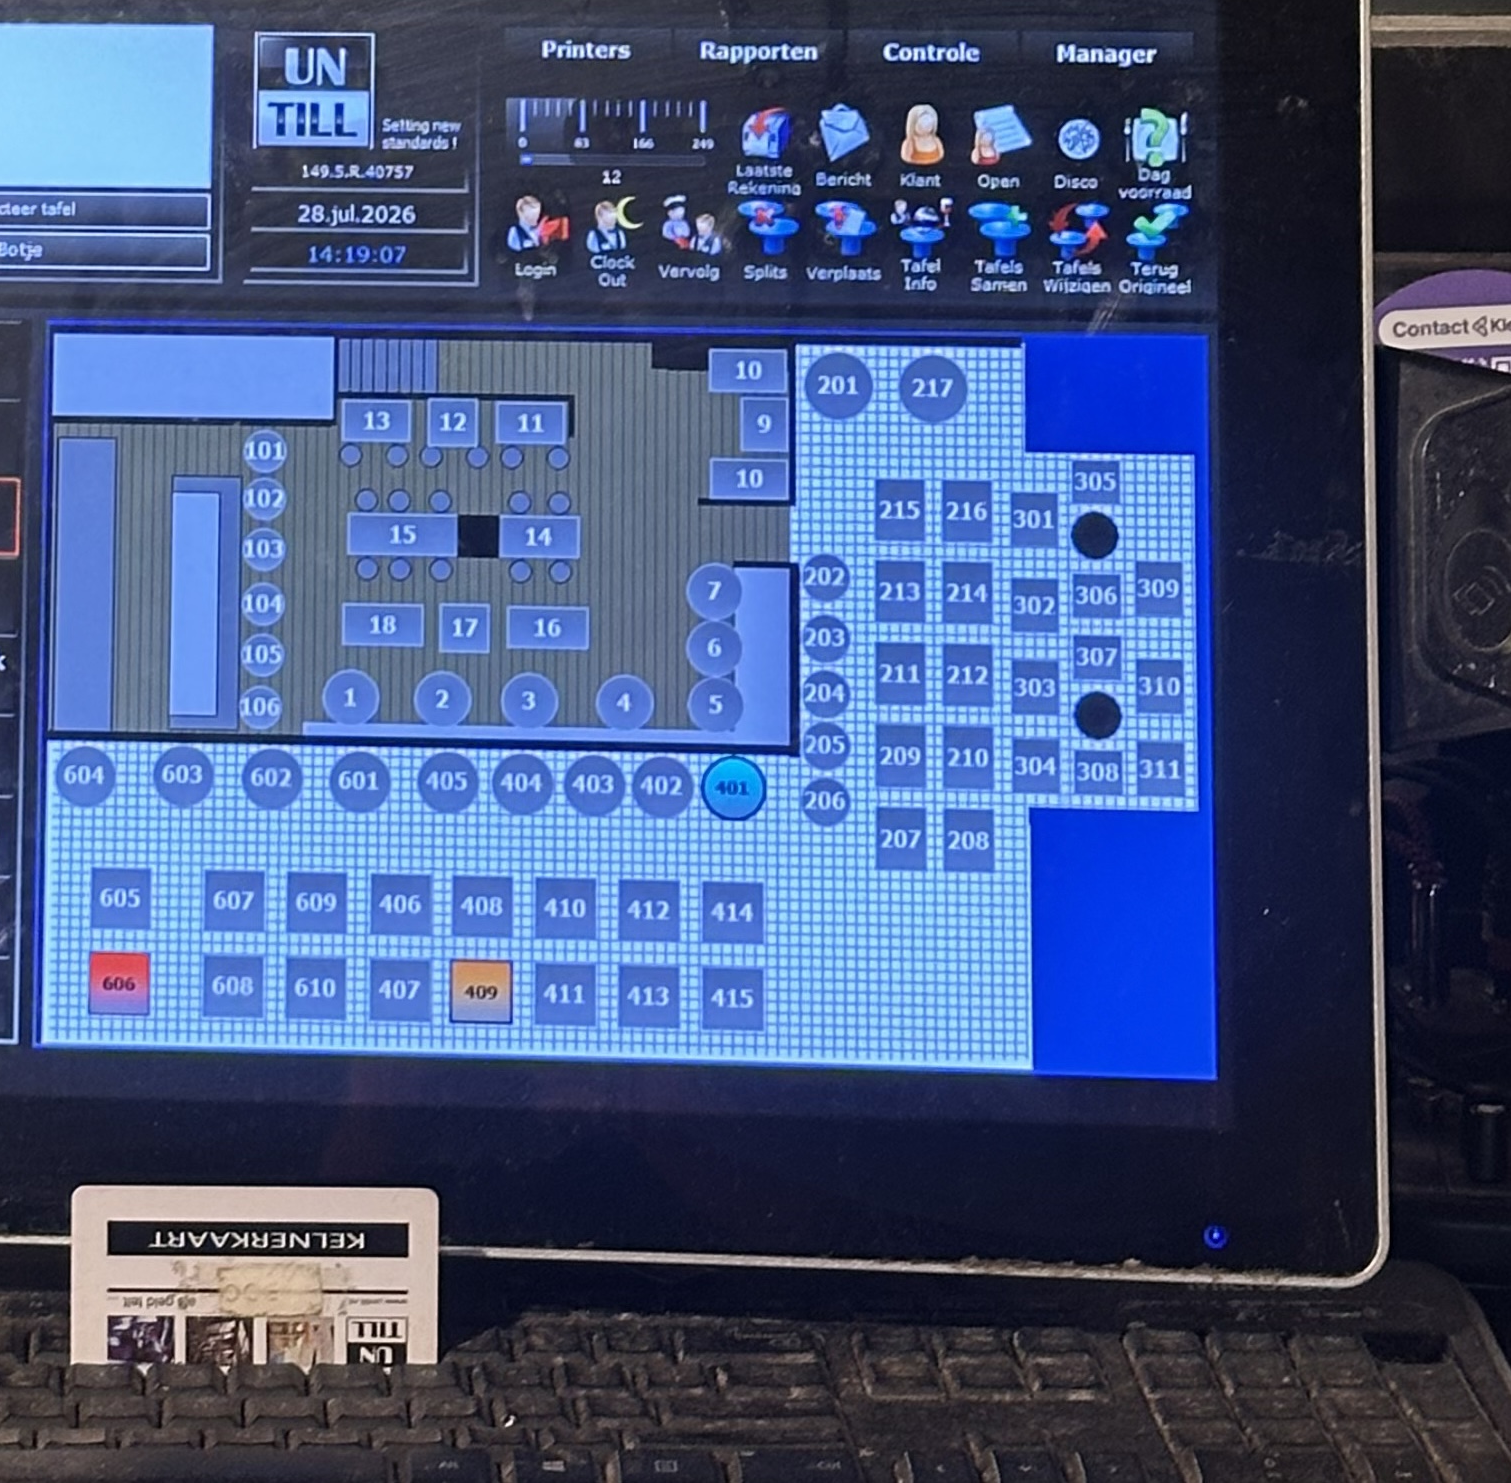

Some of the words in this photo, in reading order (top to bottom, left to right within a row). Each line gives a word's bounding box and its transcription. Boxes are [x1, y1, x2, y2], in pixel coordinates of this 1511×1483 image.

[541, 39, 632, 60] Printers
[699, 41, 818, 63] Rapporten
[883, 42, 980, 63] Controle
[1056, 43, 1157, 67] Manager
[284, 47, 346, 86] UN
[267, 102, 358, 137] TILL
[382, 118, 430, 134] Setting
[432, 120, 462, 132] new
[382, 136, 449, 150] standards
[692, 137, 714, 150] 249
[602, 170, 622, 184] 12
[736, 164, 793, 179] Laatste
[816, 172, 872, 187] Bericht
[900, 174, 941, 187] Klant
[1138, 168, 1171, 184] Dag
[728, 180, 802, 196] Rekening
[977, 174, 1020, 190] Open
[1054, 175, 1098, 189] Disco
[1118, 185, 1192, 199] voorraad
[41, 200, 77, 217] tafel
[297, 204, 416, 226] 28.jul.2026
[308, 246, 406, 264] 14:19:07
[591, 255, 635, 270] Clock
[514, 262, 557, 279] Login
[658, 264, 720, 281] Vervolg
[743, 265, 788, 282] Splits
[806, 266, 882, 282] Verplaats
[901, 258, 941, 273] Tafel
[974, 259, 1024, 274] Tafels
[1052, 260, 1102, 275] Tafels
[1130, 261, 1179, 278] Terug
[598, 273, 628, 288] Out
[905, 278, 937, 291] Info
[970, 278, 1028, 292] Samen
[1118, 279, 1192, 295] Origineel
[1393, 319, 1469, 338] Contact
[817, 375, 859, 395] 201
[912, 377, 954, 398] 217
[363, 411, 390, 431] 13
[439, 412, 467, 432] 12
[518, 413, 544, 433] 11
[756, 414, 772, 434] 9
[1074, 471, 1117, 492] 305
[879, 500, 921, 520] 215
[389, 524, 417, 545] 15
[526, 527, 552, 547] 14
[243, 540, 284, 558] 103
[707, 581, 722, 601] 7
[1137, 578, 1180, 599] 309
[1013, 595, 1055, 616] 302
[369, 615, 397, 635] 18
[534, 618, 562, 638] 16
[880, 663, 921, 684] 211
[1139, 676, 1181, 697] 310
[344, 687, 357, 708] 1
[616, 693, 631, 712] 4
[63, 764, 105, 785] 604
[338, 770, 379, 791] 601
[425, 771, 468, 791] 405
[714, 780, 750, 796] 401
[99, 887, 141, 908] 605
[460, 896, 503, 917] 408
[711, 902, 754, 923] 414
[102, 975, 136, 992] 606
[464, 985, 498, 1001] 409
[710, 988, 754, 1009] 415
[148, 1230, 366, 1250] KELNERKAART
[146, 1294, 175, 1309] geld
[351, 1321, 402, 1338] TILL
[359, 1346, 392, 1364] UN
